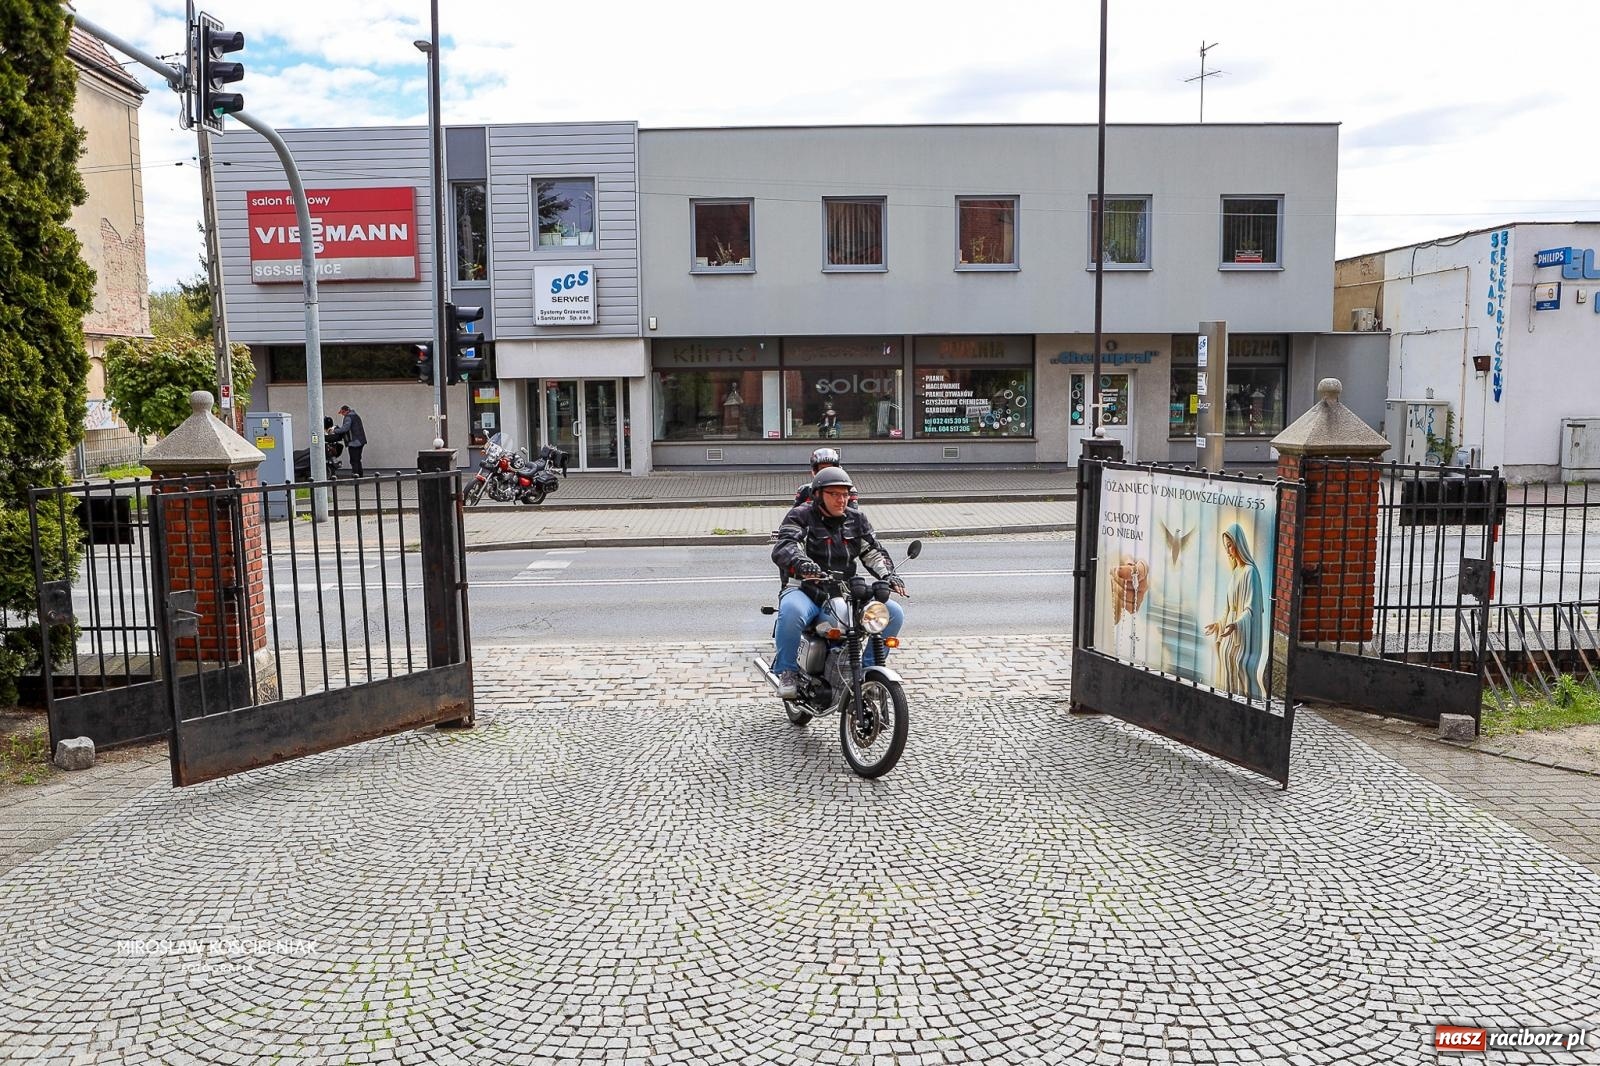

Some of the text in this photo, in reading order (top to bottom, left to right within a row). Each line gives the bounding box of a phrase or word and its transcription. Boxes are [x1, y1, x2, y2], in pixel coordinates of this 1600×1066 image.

[251, 195, 331, 206] salon fiowy
[1537, 251, 1564, 264] PHILIPS
[254, 263, 342, 277] SGS-SEVICE
[551, 270, 589, 294] SGS
[816, 374, 894, 394] solar
[1104, 480, 1266, 511] ÓŻANIEC W DNI POWSZEDNIE 5:55
[1102, 525, 1144, 541] DO NIEBA!
